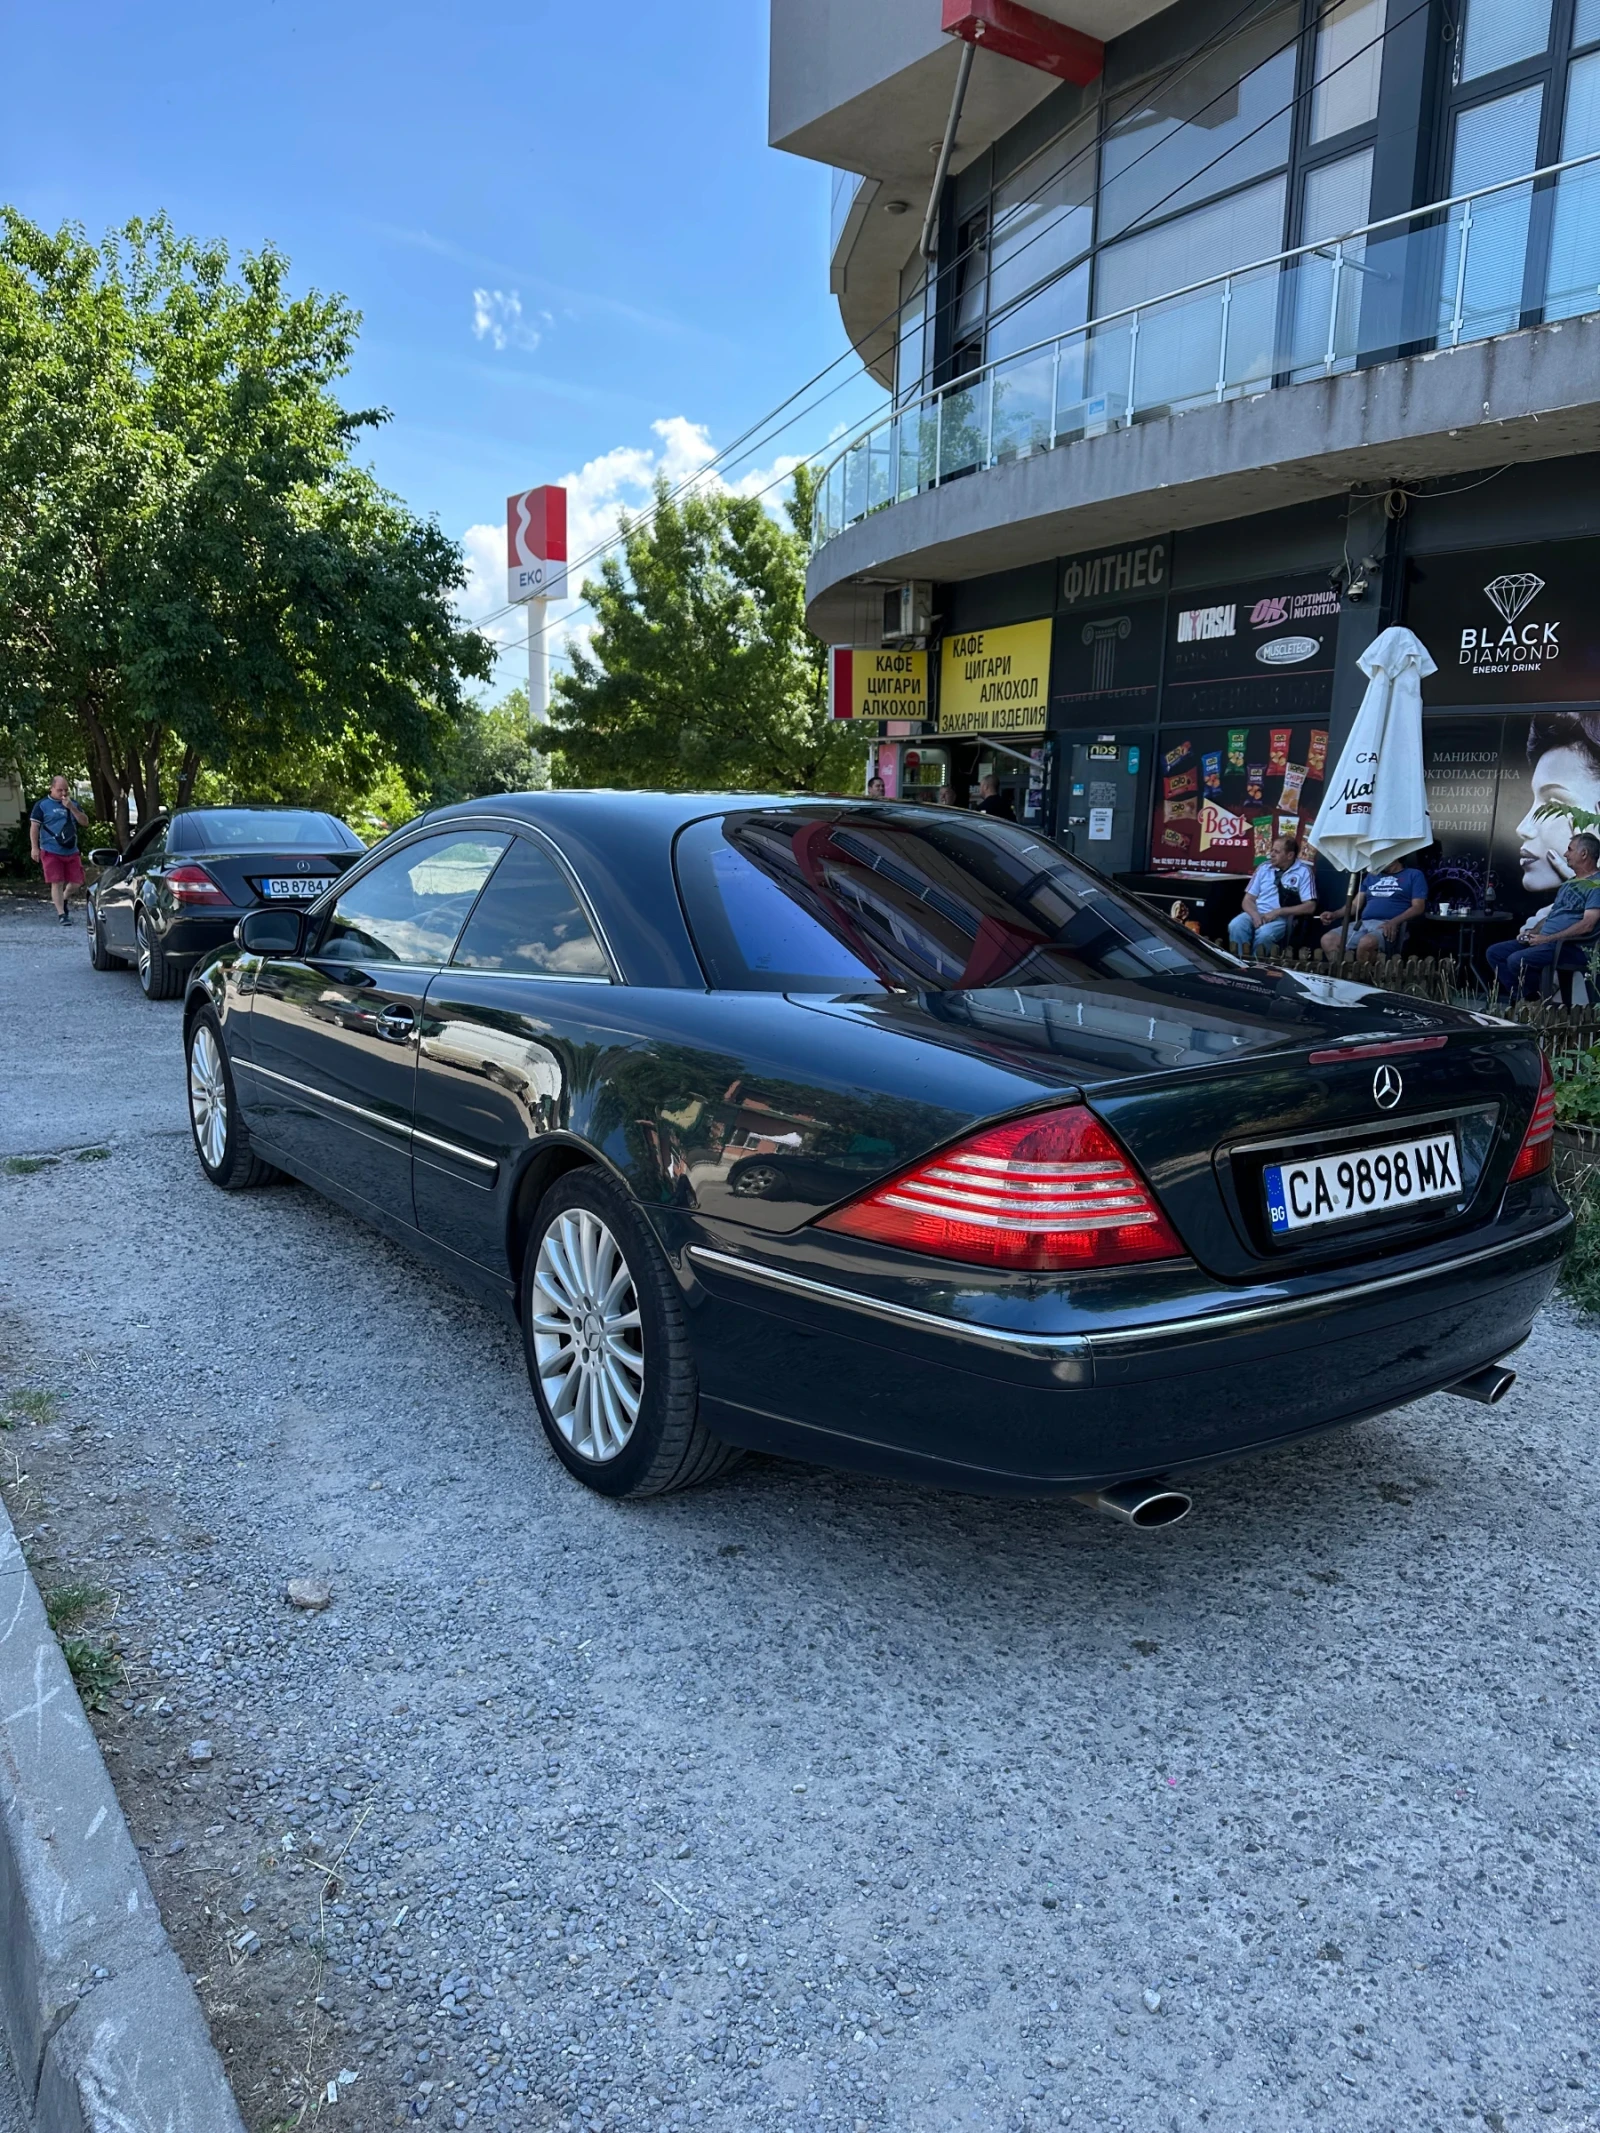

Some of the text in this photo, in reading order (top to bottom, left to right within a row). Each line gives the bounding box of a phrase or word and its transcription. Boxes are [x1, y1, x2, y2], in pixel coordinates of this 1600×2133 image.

[520, 568, 543, 587] EKO
[1064, 545, 1165, 603] ФИТНЕС
[1294, 591, 1337, 607] OPTIMUM
[1250, 597, 1288, 624] ON
[1293, 602, 1341, 619] NUTRITION
[1461, 622, 1560, 649] BLACK
[953, 634, 984, 658] КАФЕ
[1263, 641, 1312, 660] MUSCLETECH
[1459, 644, 1560, 665] DIAMOND
[876, 655, 913, 673] КАФЕ
[964, 655, 1011, 684] ЦИГАРИ
[1472, 663, 1542, 675] ENERGY DRINK
[867, 678, 921, 697] ЦИГАРИ
[979, 677, 1039, 703] АЛКОХОЛ
[862, 700, 927, 716] АЛКОХОЛ
[941, 705, 1047, 732] ЗАХАРНИ ИЗДЕЛИЯ
[1432, 752, 1498, 762] МАНИКЮР
[1431, 786, 1493, 798] ПЕДИКЮР
[1427, 803, 1493, 815] СОЛАРИУМ
[1198, 806, 1246, 836] Best
[1431, 820, 1487, 832] ТЕРАПИИ
[1212, 838, 1248, 847] FOODS
[271, 881, 289, 893] CB
[292, 880, 324, 893] 8784
[1289, 1141, 1457, 1219] CA 9898 MX
[1270, 1206, 1286, 1222] BG
